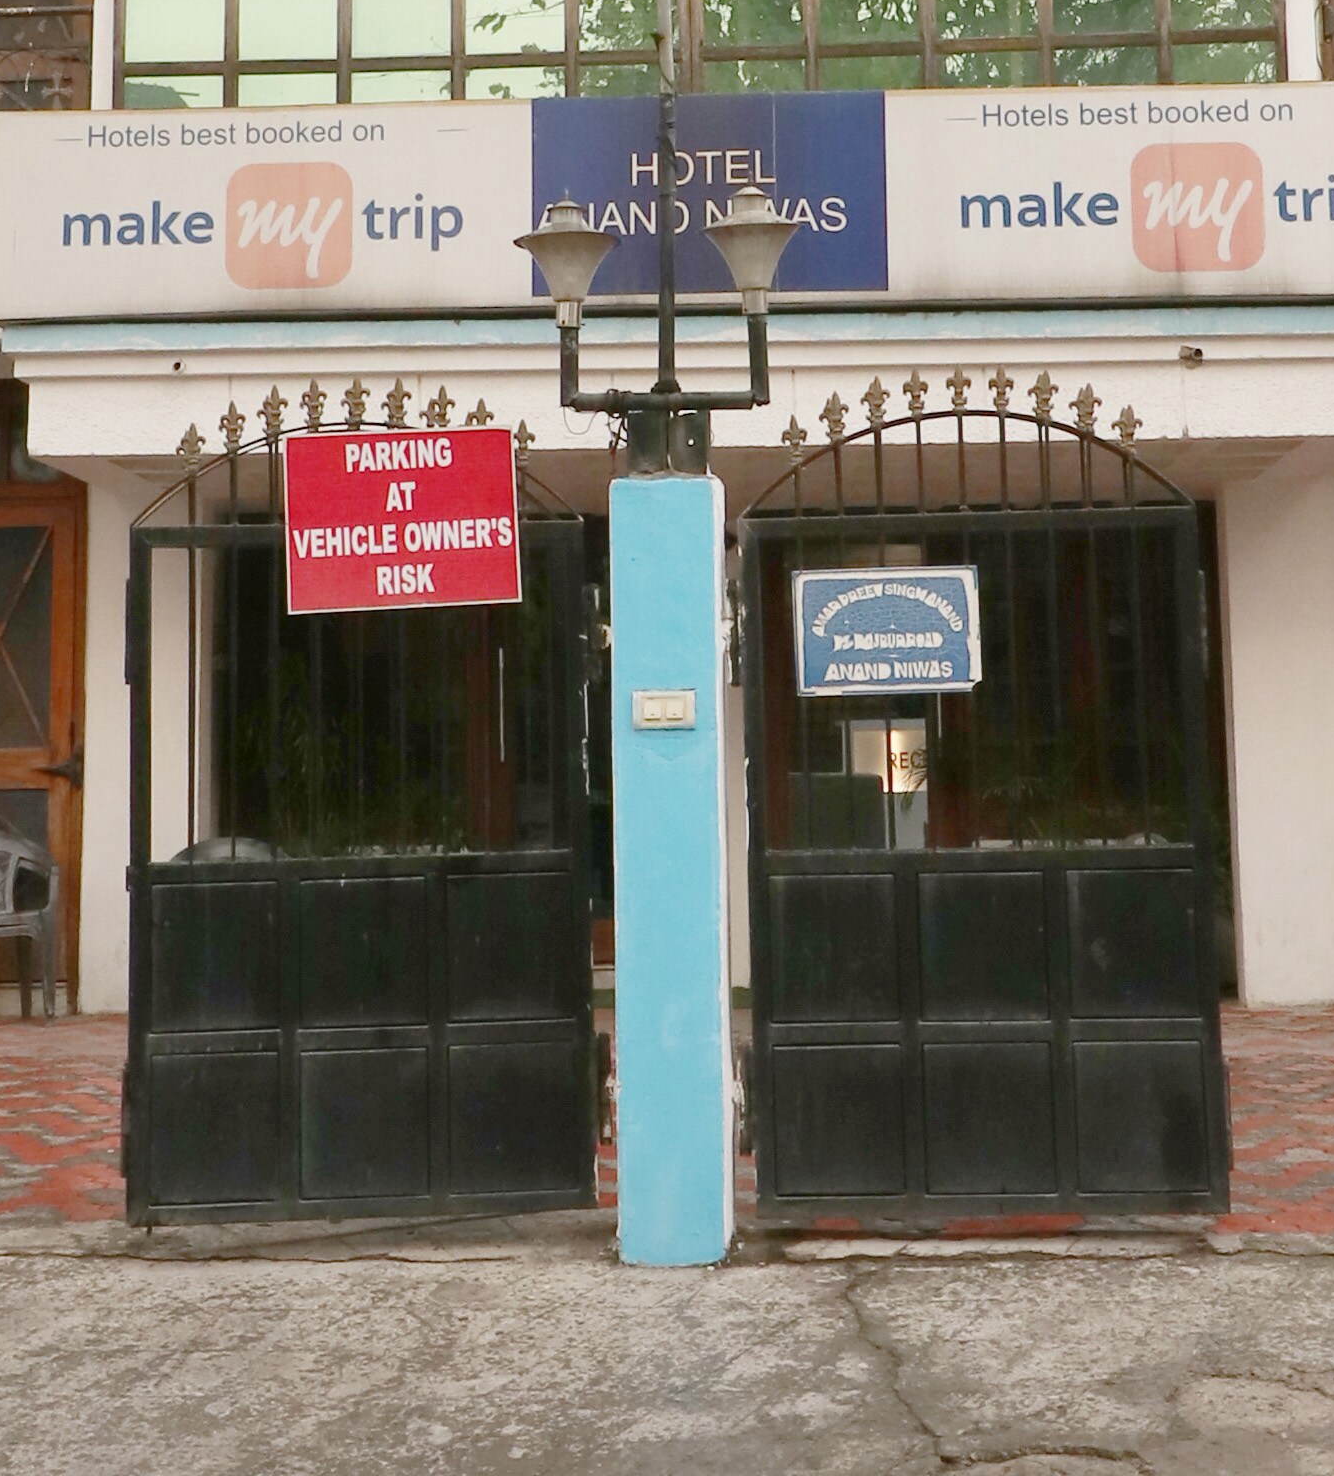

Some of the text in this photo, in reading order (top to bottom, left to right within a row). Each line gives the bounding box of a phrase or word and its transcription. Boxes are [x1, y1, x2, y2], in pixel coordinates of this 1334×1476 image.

[981, 99, 1294, 127] Hotels best booked on
[87, 120, 386, 148] Hotels best booked on
[631, 149, 777, 186] HOTEL
[705, 196, 848, 232] NWAS
[960, 180, 1119, 228] make
[1143, 178, 1254, 262] my
[62, 193, 464, 279] make my trip
[345, 437, 453, 473] PARKING
[386, 481, 416, 512] AT
[293, 516, 513, 559] VEHICLE OWNER'S
[376, 562, 435, 596] RISK
[924, 592, 964, 633] ANAND
[905, 631, 944, 649] ROAD
[824, 659, 954, 682] ANAND NIWAS
